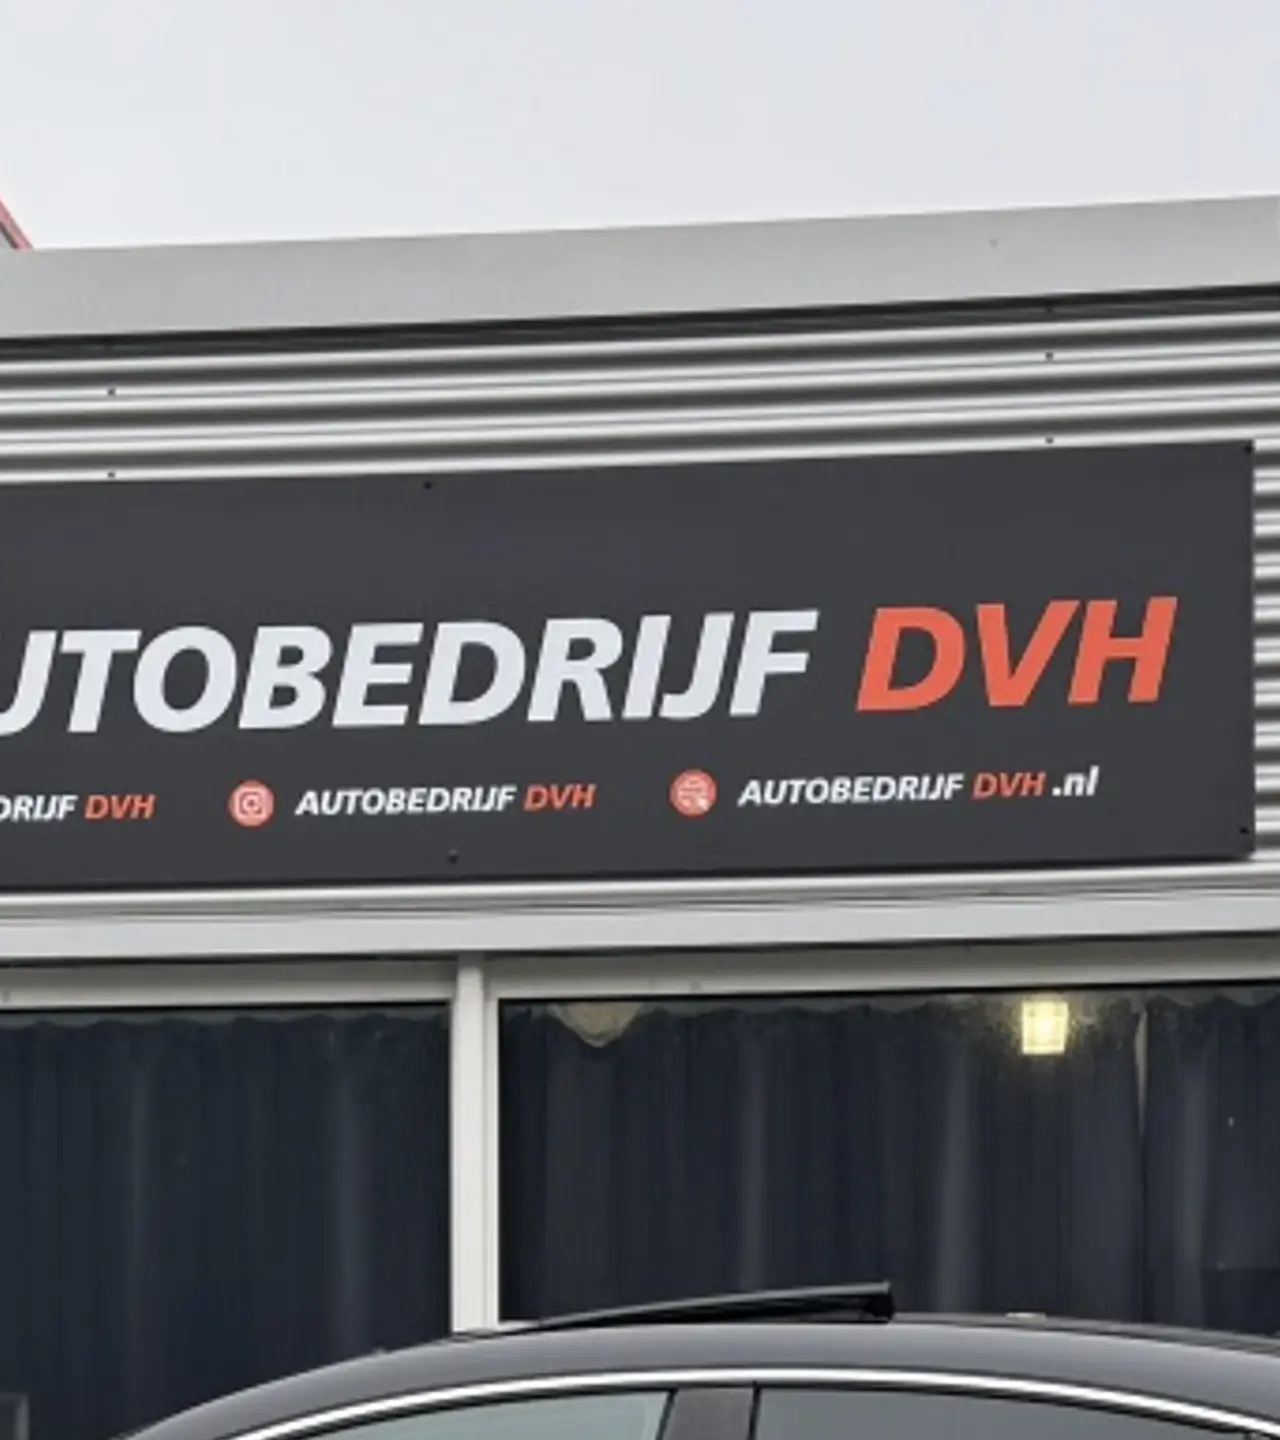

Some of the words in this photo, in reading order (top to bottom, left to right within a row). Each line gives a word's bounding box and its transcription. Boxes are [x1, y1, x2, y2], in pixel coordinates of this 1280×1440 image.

[855, 595, 1178, 713] DVH
[83, 793, 156, 820] DVH
[293, 784, 518, 816] AUTOBEDRIJF
[523, 783, 597, 812] DVH
[736, 773, 965, 808] AUTOBEDRIJF
